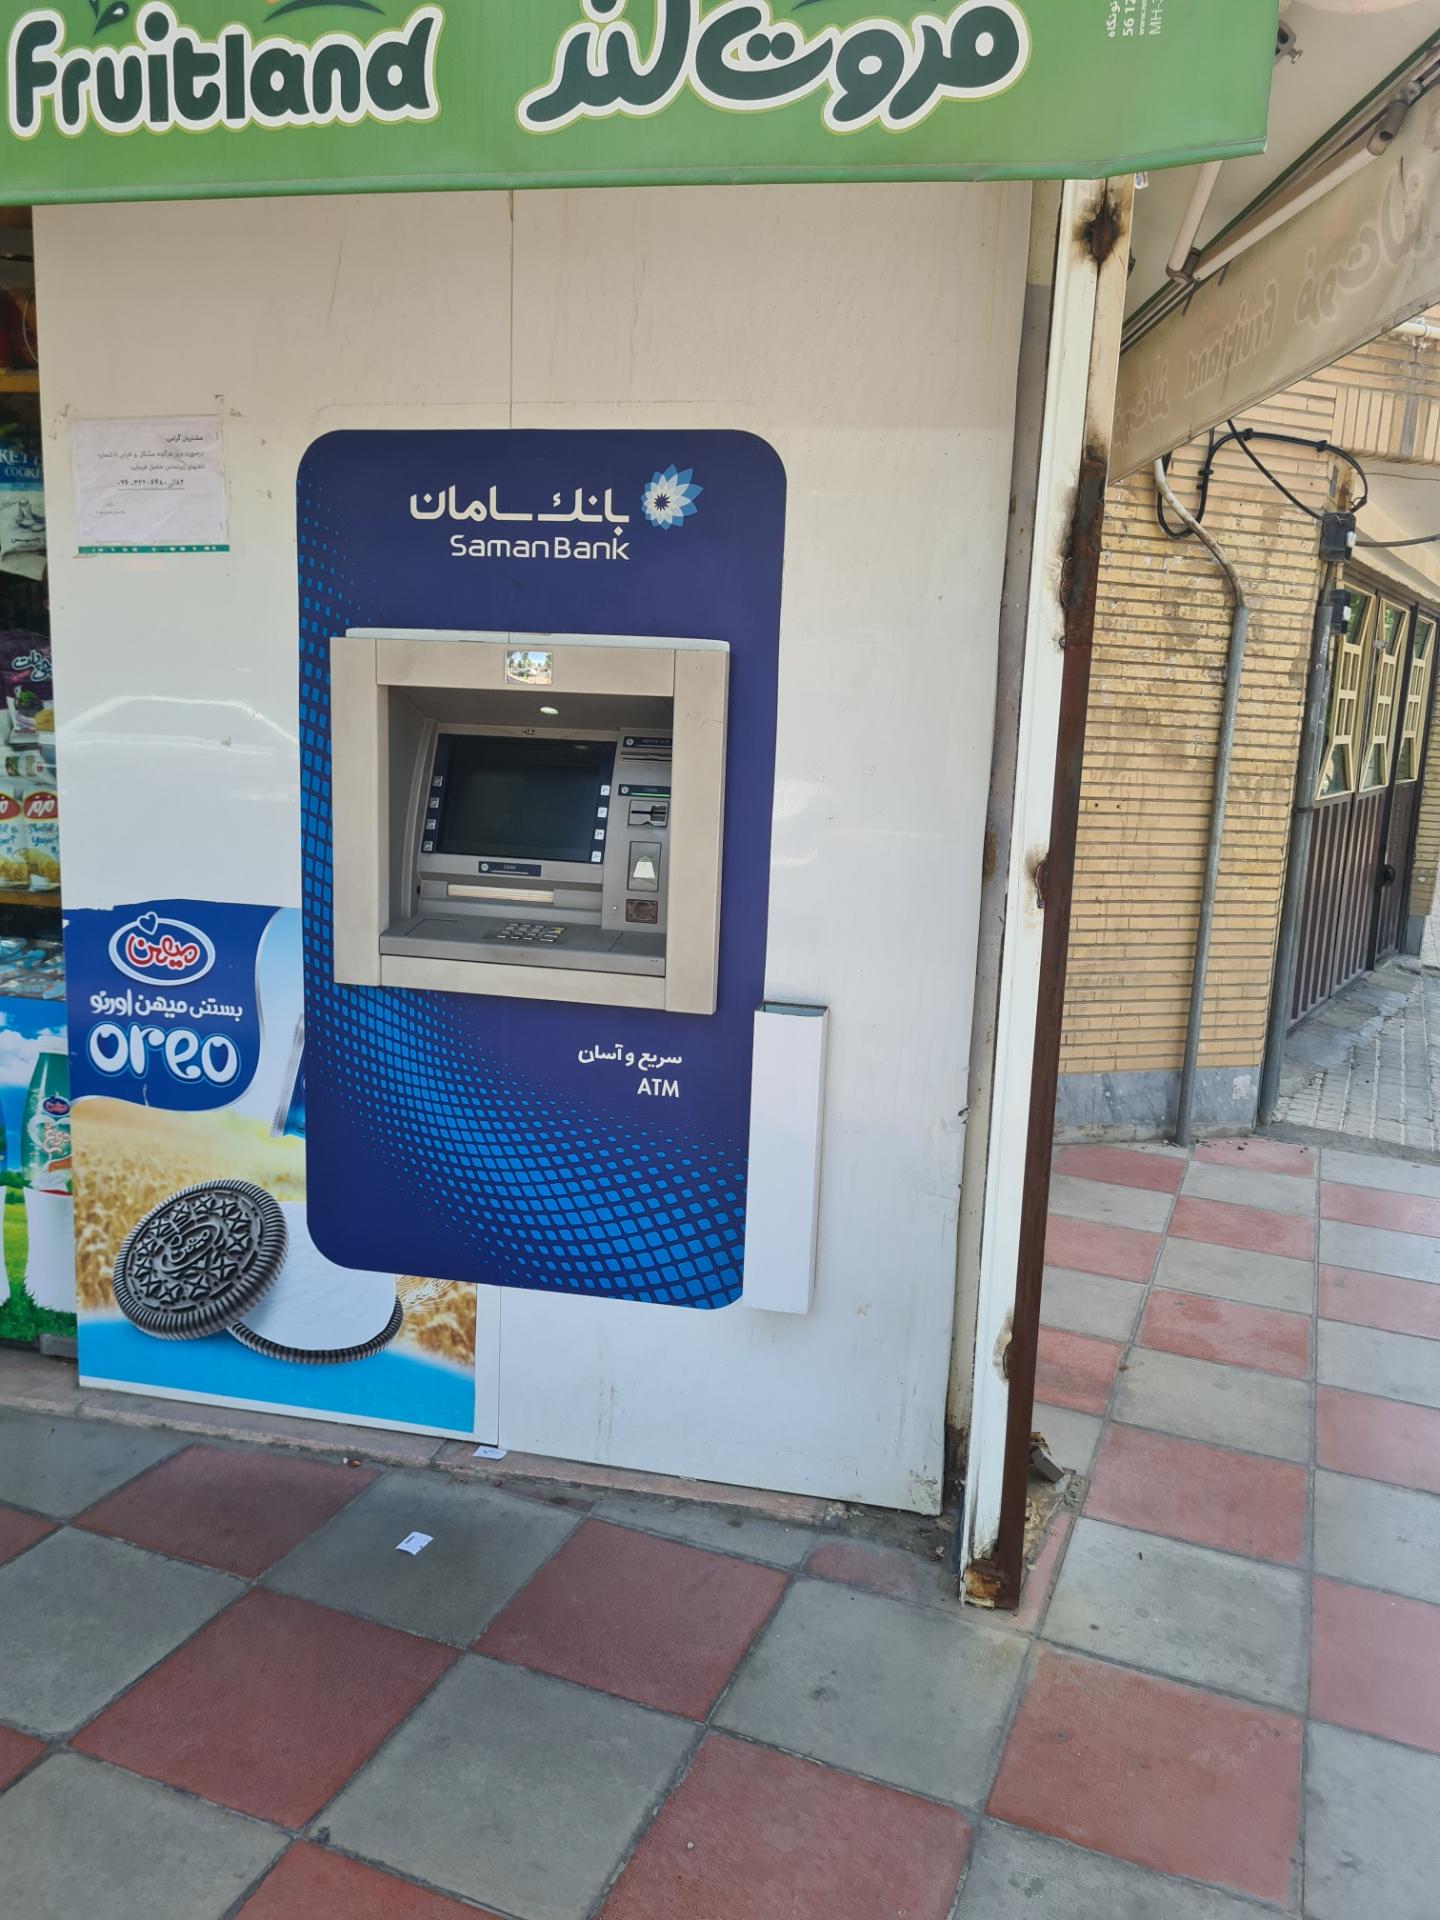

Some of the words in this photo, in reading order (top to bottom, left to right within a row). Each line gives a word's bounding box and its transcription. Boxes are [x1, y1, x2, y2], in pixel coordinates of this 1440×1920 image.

[1122, 18, 1135, 37] 56
[410, 484, 533, 522] سامان
[538, 487, 630, 537] بانک
[450, 534, 549, 558] Saman
[554, 536, 630, 560] Bank
[125, 932, 200, 970] میهن
[134, 994, 188, 1019] میهن
[189, 998, 243, 1022] بستنی
[578, 1043, 624, 1064] آسان
[625, 1051, 635, 1066] و
[637, 1051, 683, 1071] سریع
[636, 1077, 680, 1098] ATM
